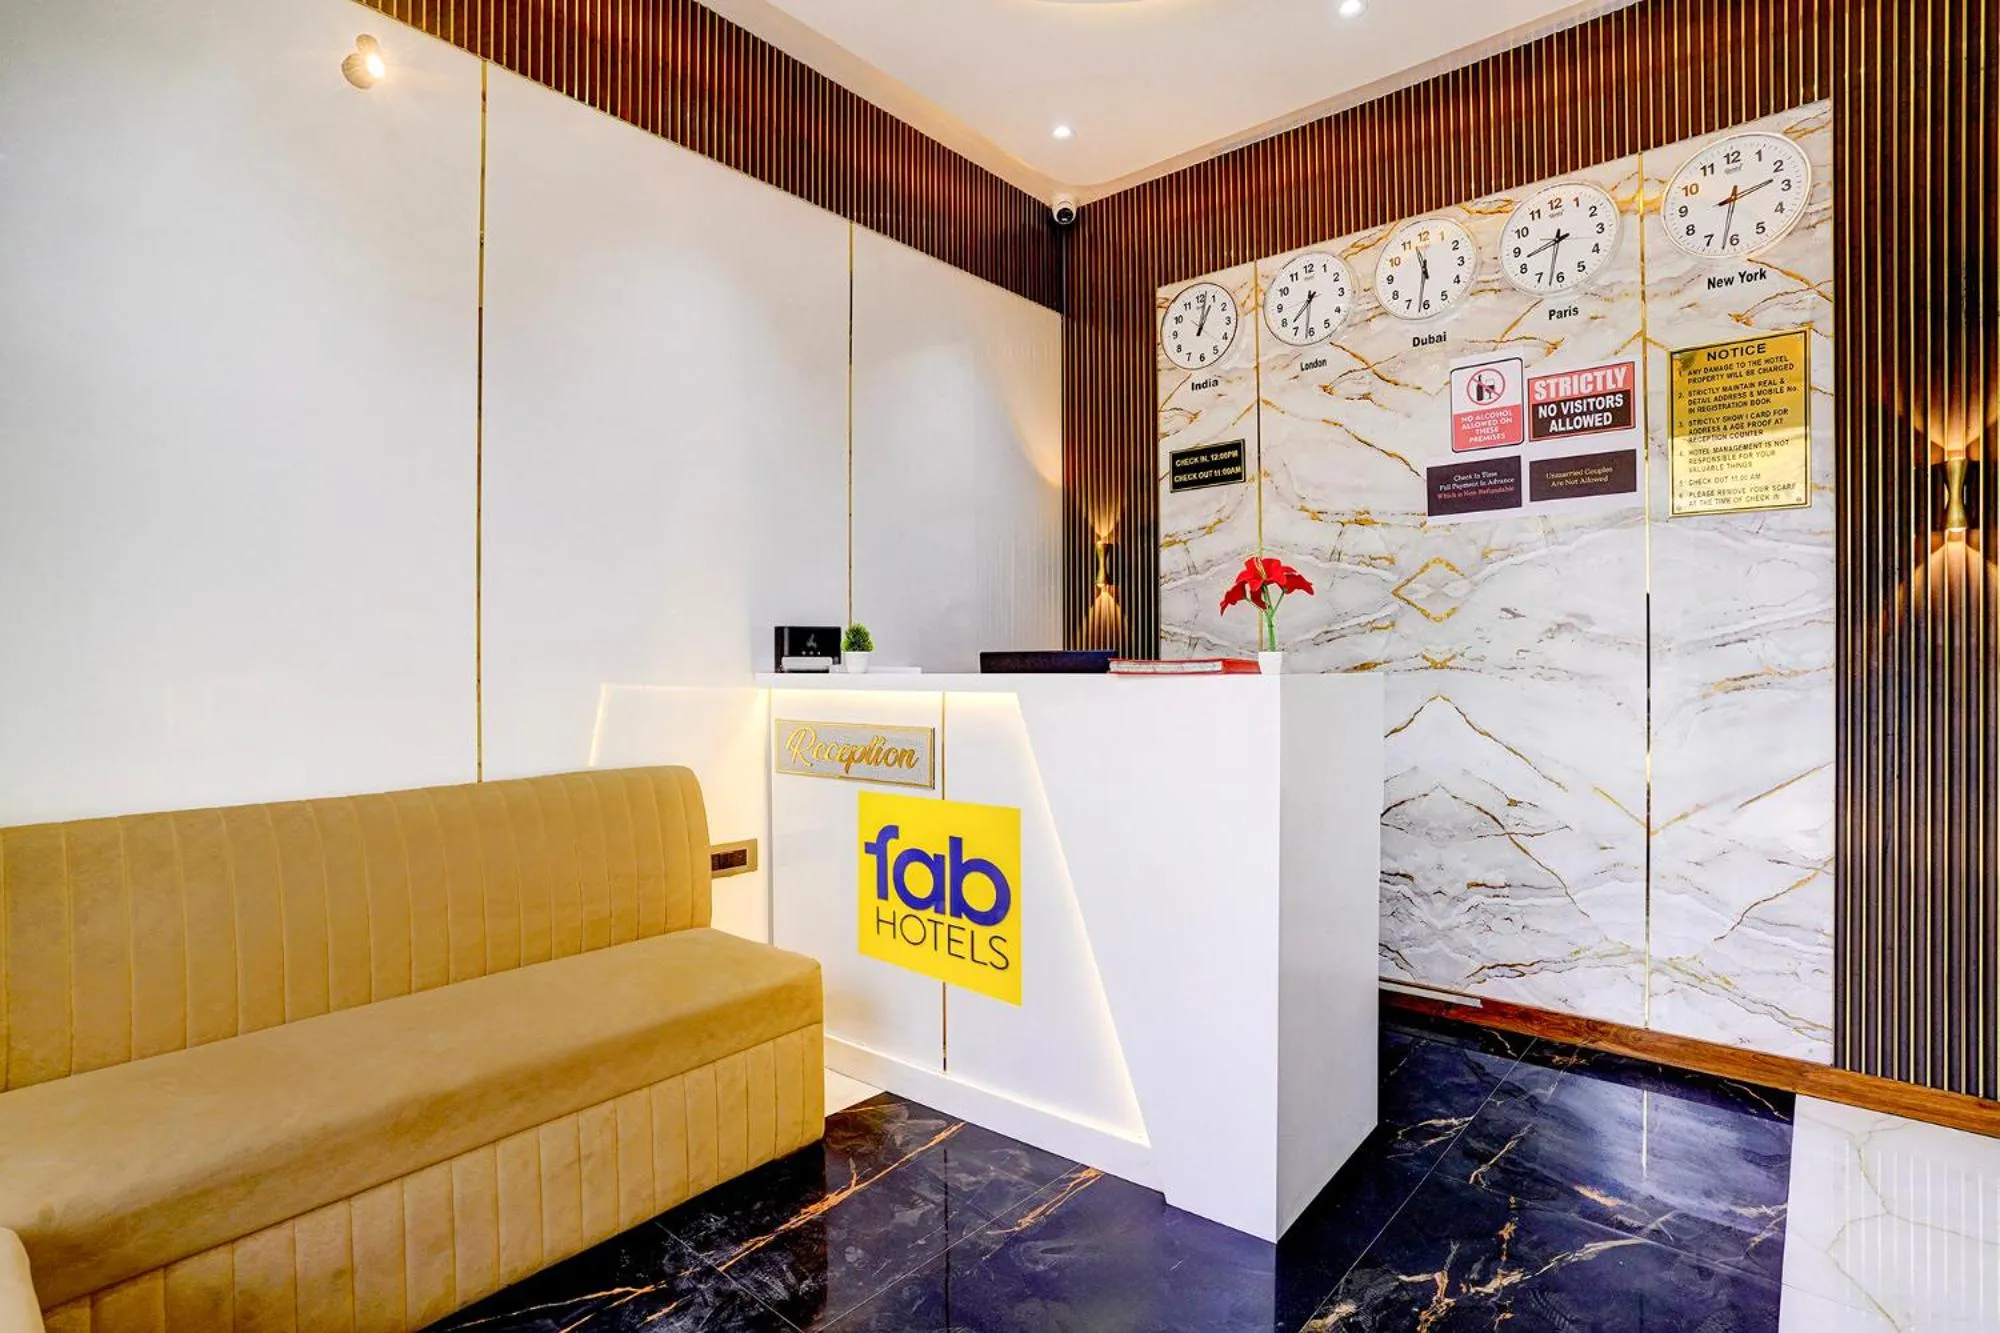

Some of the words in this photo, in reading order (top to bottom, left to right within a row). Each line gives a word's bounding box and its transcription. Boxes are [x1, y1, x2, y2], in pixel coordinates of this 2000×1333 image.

[1724, 151, 1741, 164] 12
[1756, 150, 1762, 161] 1
[1701, 163, 1714, 176] 11
[1773, 160, 1784, 173] 2
[1682, 184, 1699, 196] 10
[1781, 179, 1792, 191] 3
[1548, 198, 1562, 210] 12
[1573, 197, 1579, 207] 1
[1589, 206, 1597, 217] 2
[1679, 206, 1688, 217] 9
[1775, 202, 1785, 213] 4
[1529, 209, 1540, 220] 11
[1515, 227, 1529, 239] 10
[1596, 223, 1604, 234] 3
[1686, 224, 1695, 236] 8
[1756, 222, 1765, 234] 5
[1418, 231, 1429, 241] 12
[1440, 231, 1444, 240] 1
[1704, 234, 1714, 246] 7
[1730, 234, 1739, 246] 6
[1401, 241, 1411, 250] 11
[1452, 240, 1459, 250] 2
[1592, 243, 1600, 254] 4
[1513, 247, 1521, 257] 9
[1389, 257, 1400, 267] 10
[1457, 256, 1464, 266] 3
[1304, 264, 1314, 273] 12
[1323, 264, 1327, 272] 1
[1520, 264, 1528, 273] 8
[1577, 261, 1585, 272] 5
[1289, 272, 1298, 281] 11
[1333, 272, 1339, 281] 2
[1387, 275, 1394, 284] 9
[1453, 275, 1460, 284] 4
[1535, 272, 1543, 283] 7
[1556, 272, 1564, 282] 6
[1708, 276, 1734, 289] New
[1738, 268, 1766, 283] York
[1280, 287, 1289, 296] 10
[1338, 288, 1344, 296] 3
[1392, 290, 1399, 300] 8
[1441, 291, 1448, 301] 5
[1196, 294, 1205, 303] 12
[1184, 303, 1191, 311] 11
[1221, 303, 1227, 311] 2
[1277, 304, 1283, 312] 9
[1406, 300, 1412, 310] 7
[1423, 300, 1430, 309] 6
[1549, 306, 1579, 320] Paris
[1174, 315, 1183, 324] 10
[1225, 316, 1231, 325] 3
[1281, 319, 1288, 327] 8
[1324, 319, 1330, 328] 5
[1173, 331, 1178, 339] 9
[1223, 332, 1228, 340] 4
[1293, 327, 1299, 336] 7
[1308, 328, 1315, 336] 6
[1413, 332, 1446, 347] Dubai
[1177, 344, 1182, 352] 8
[1213, 345, 1219, 354] 5
[1707, 343, 1767, 361] NOTICE
[1186, 352, 1192, 360] 7
[1200, 353, 1205, 361] 6
[1300, 359, 1327, 371] London
[1704, 365, 1733, 373] DAMAGE
[1764, 355, 1788, 364] HOTEL
[1688, 372, 1724, 384] PROPERTY
[1727, 371, 1742, 379] WILL
[1758, 363, 1794, 374] CHARGED
[1192, 379, 1219, 391] India
[1535, 367, 1627, 400] STRICTLY
[1688, 387, 1720, 397] STRICTLY
[1722, 382, 1755, 392] MAINTAIN
[1758, 380, 1777, 388] REAL
[1688, 397, 1711, 406] DETAIL
[1714, 392, 1747, 402] ADDRESS
[1757, 386, 1784, 395] MOBILE
[1539, 404, 1557, 418] NO
[1561, 394, 1623, 415] VISITORS
[1697, 400, 1748, 413] REGISTRATION
[1475, 410, 1512, 421] ALCOHOL
[1688, 417, 1720, 426] STRICTLY
[1751, 410, 1771, 419] CARD
[1773, 408, 1788, 416] FOR
[1462, 420, 1498, 430] ALLOWED
[1500, 417, 1512, 425] ON
[1549, 412, 1612, 432] ALLOWED
[1688, 425, 1720, 435] ADDRESS
[1730, 422, 1744, 430] AGE
[1747, 418, 1771, 428] PROOF
[1476, 426, 1499, 434] THESE
[1729, 430, 1764, 439] COUNTER
[1470, 433, 1505, 443] PREMISES
[1689, 448, 1709, 456] HOTEL
[1713, 443, 1762, 453] MANAGEMENT
[1774, 439, 1789, 447] NOT
[1688, 453, 1736, 464] RESPONSIBLE
[1739, 452, 1752, 460] FOR
[1756, 450, 1775, 458] YOUR
[1176, 458, 1199, 467] CHECK
[1174, 473, 1197, 482] CHECK
[1199, 471, 1212, 479] OUT
[1546, 469, 1583, 479] Unmarried
[1585, 466, 1613, 475] Couples
[1580, 475, 1609, 484] Allowed
[1689, 478, 1711, 486] CHECK
[1452, 482, 1479, 490] Payment
[1689, 489, 1714, 498] PLEASE
[785, 726, 919, 775] Reception
[864, 824, 1010, 926] fab
[876, 906, 1009, 971] HOTELS
